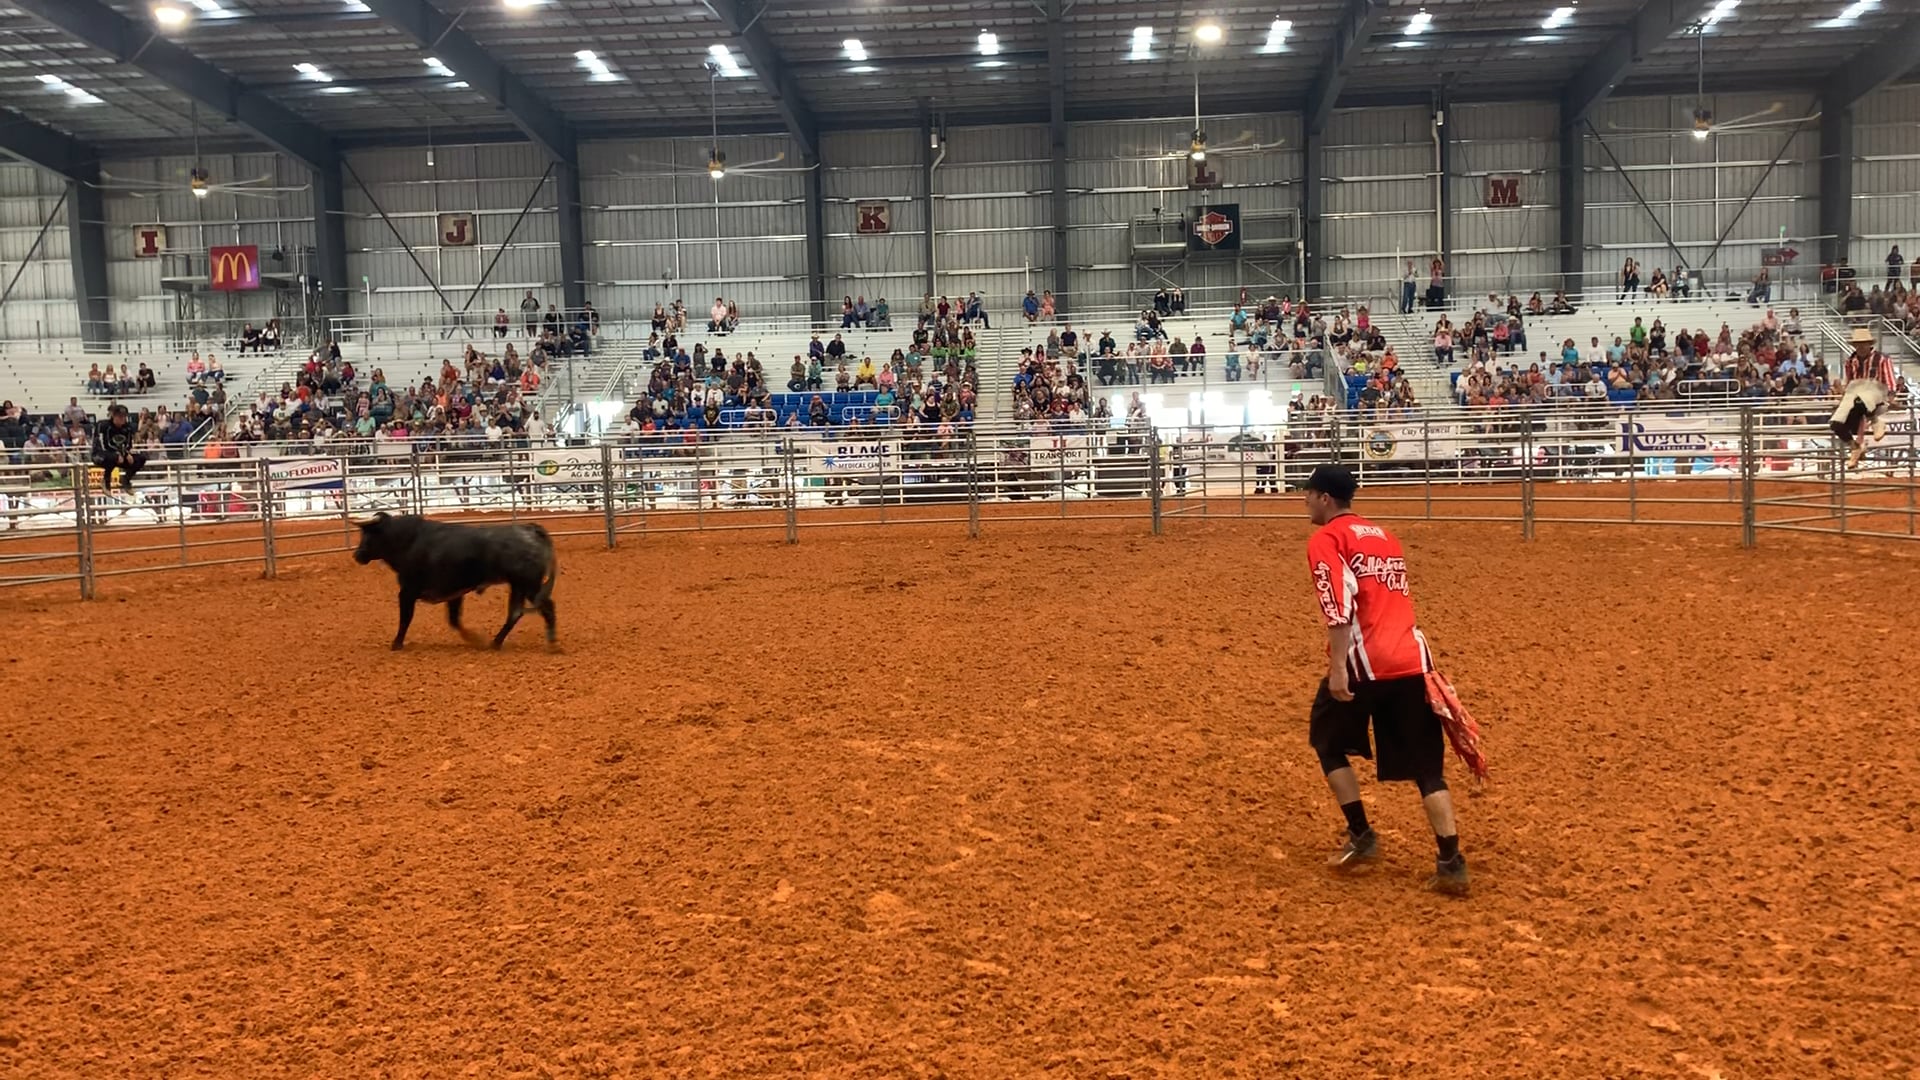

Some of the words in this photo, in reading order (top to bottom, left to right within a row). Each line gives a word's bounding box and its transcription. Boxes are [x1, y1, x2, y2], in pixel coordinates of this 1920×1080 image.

[1195, 159, 1217, 184] L
[1491, 179, 1519, 204] M
[860, 206, 886, 230] K
[141, 231, 158, 254] I
[445, 219, 467, 243] J
[837, 445, 891, 459] BLAKE
[867, 461, 892, 469] CENER
[1386, 573, 1410, 596] Only
